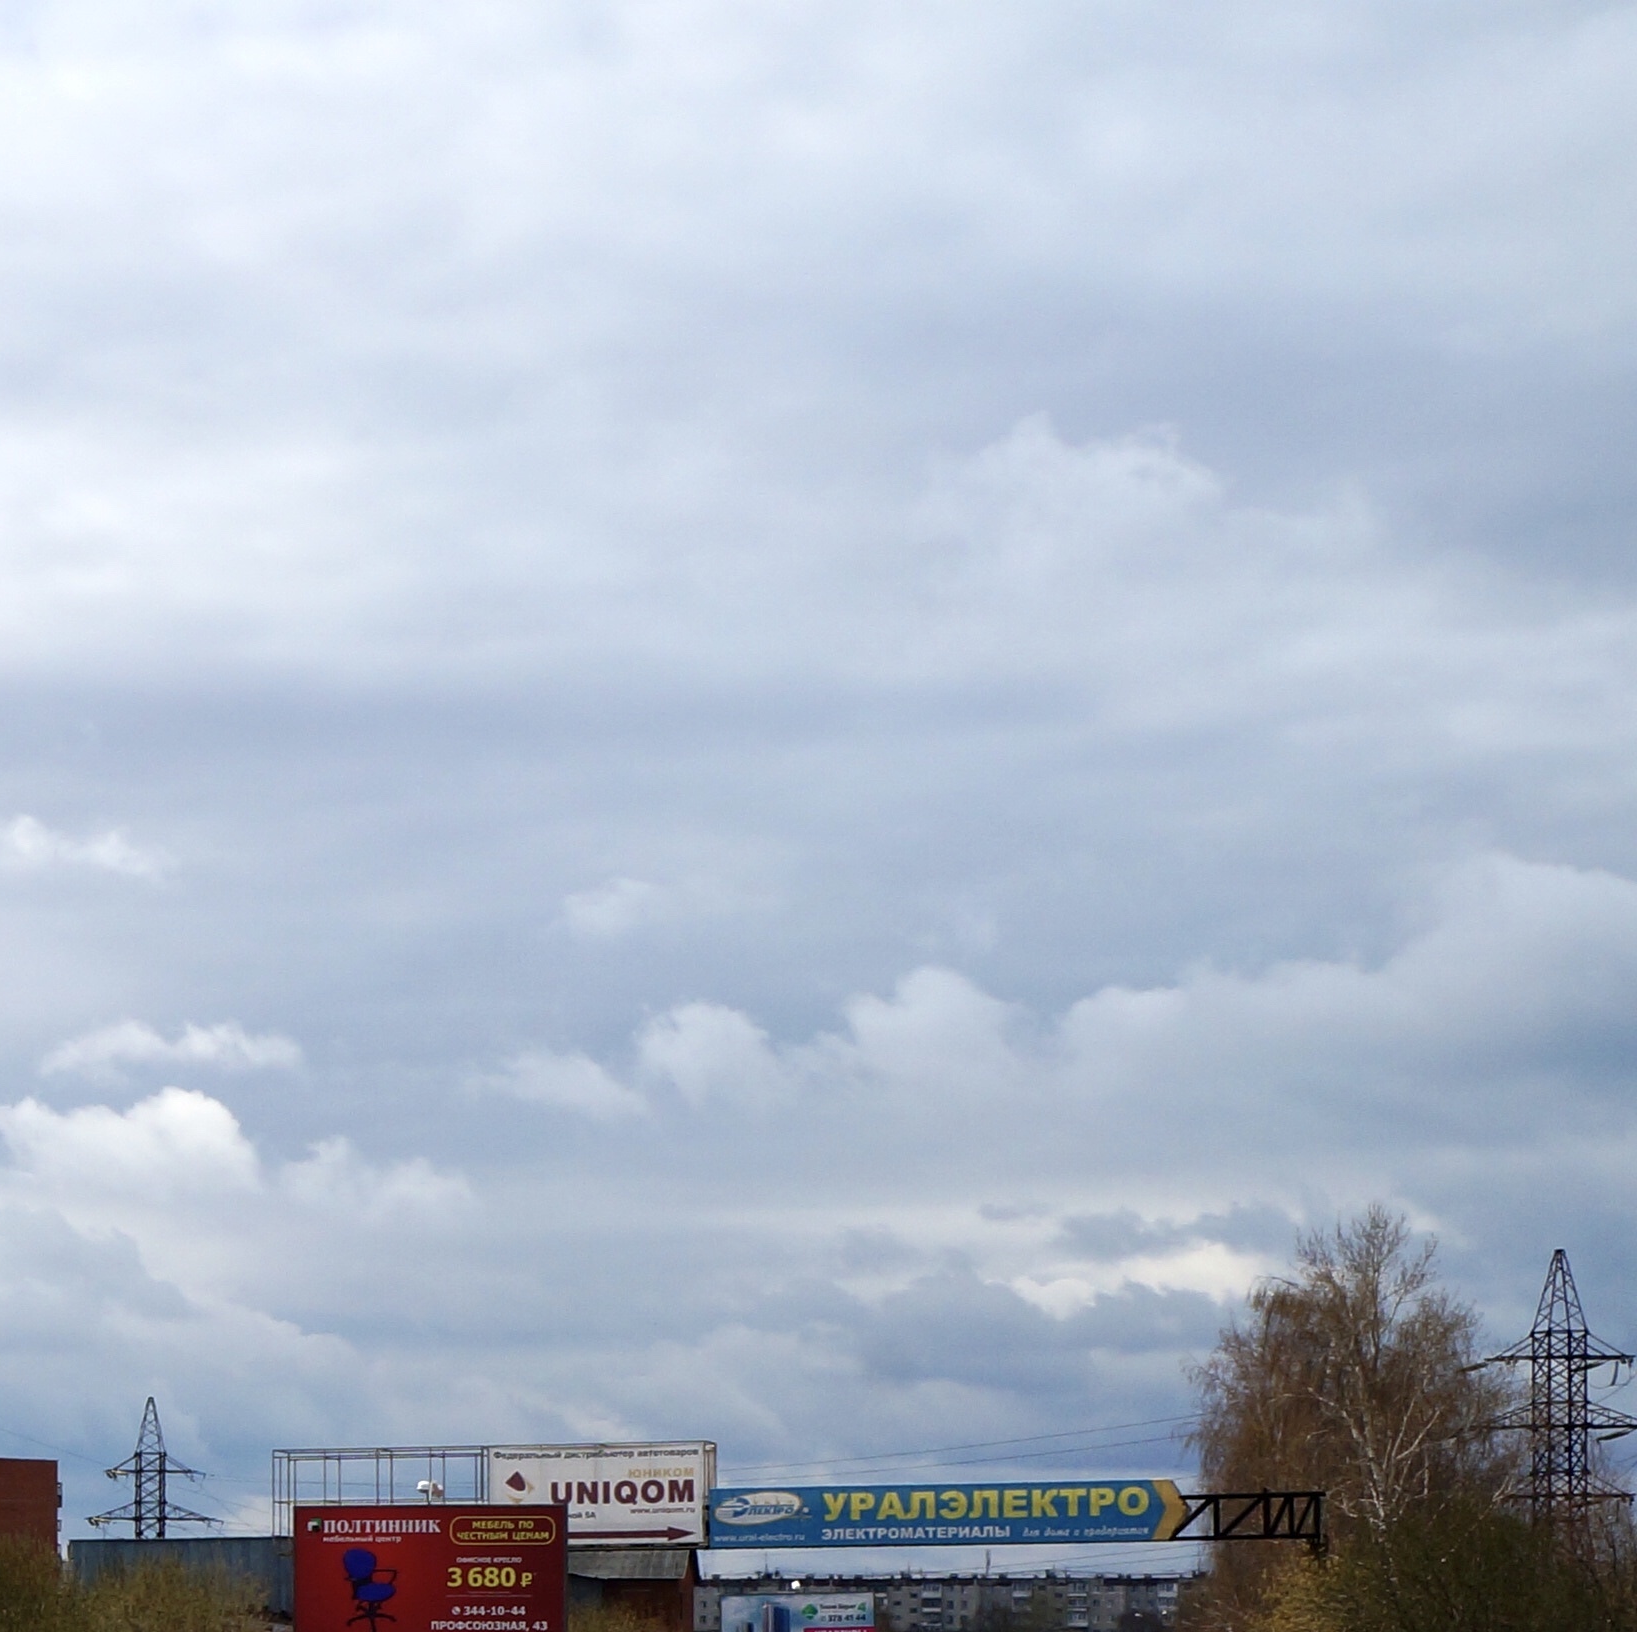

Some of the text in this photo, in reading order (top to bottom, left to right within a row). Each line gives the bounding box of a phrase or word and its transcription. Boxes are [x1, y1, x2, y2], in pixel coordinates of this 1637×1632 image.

[628, 1467, 695, 1479] ЮНИКОМ
[550, 1478, 695, 1505] UNIQOM
[822, 1486, 1150, 1522] УРАЛЭЛЕКТРО
[323, 1519, 441, 1534] ПОЛТИННИК
[471, 1520, 534, 1530] МЕБЕЛЬ ПО
[375, 1534, 402, 1544] центр
[456, 1530, 550, 1541] ЧЕСТНЫМ ЦЕНАМ
[713, 1532, 806, 1543] www.ural-electro.ru
[821, 1525, 1011, 1541] ЭЛЕКТРОМАТЕРИАЛЫ
[463, 1606, 526, 1616] 344-10-44
[430, 1620, 548, 1632] ПРОФСОЮЗНАЯ, 43
